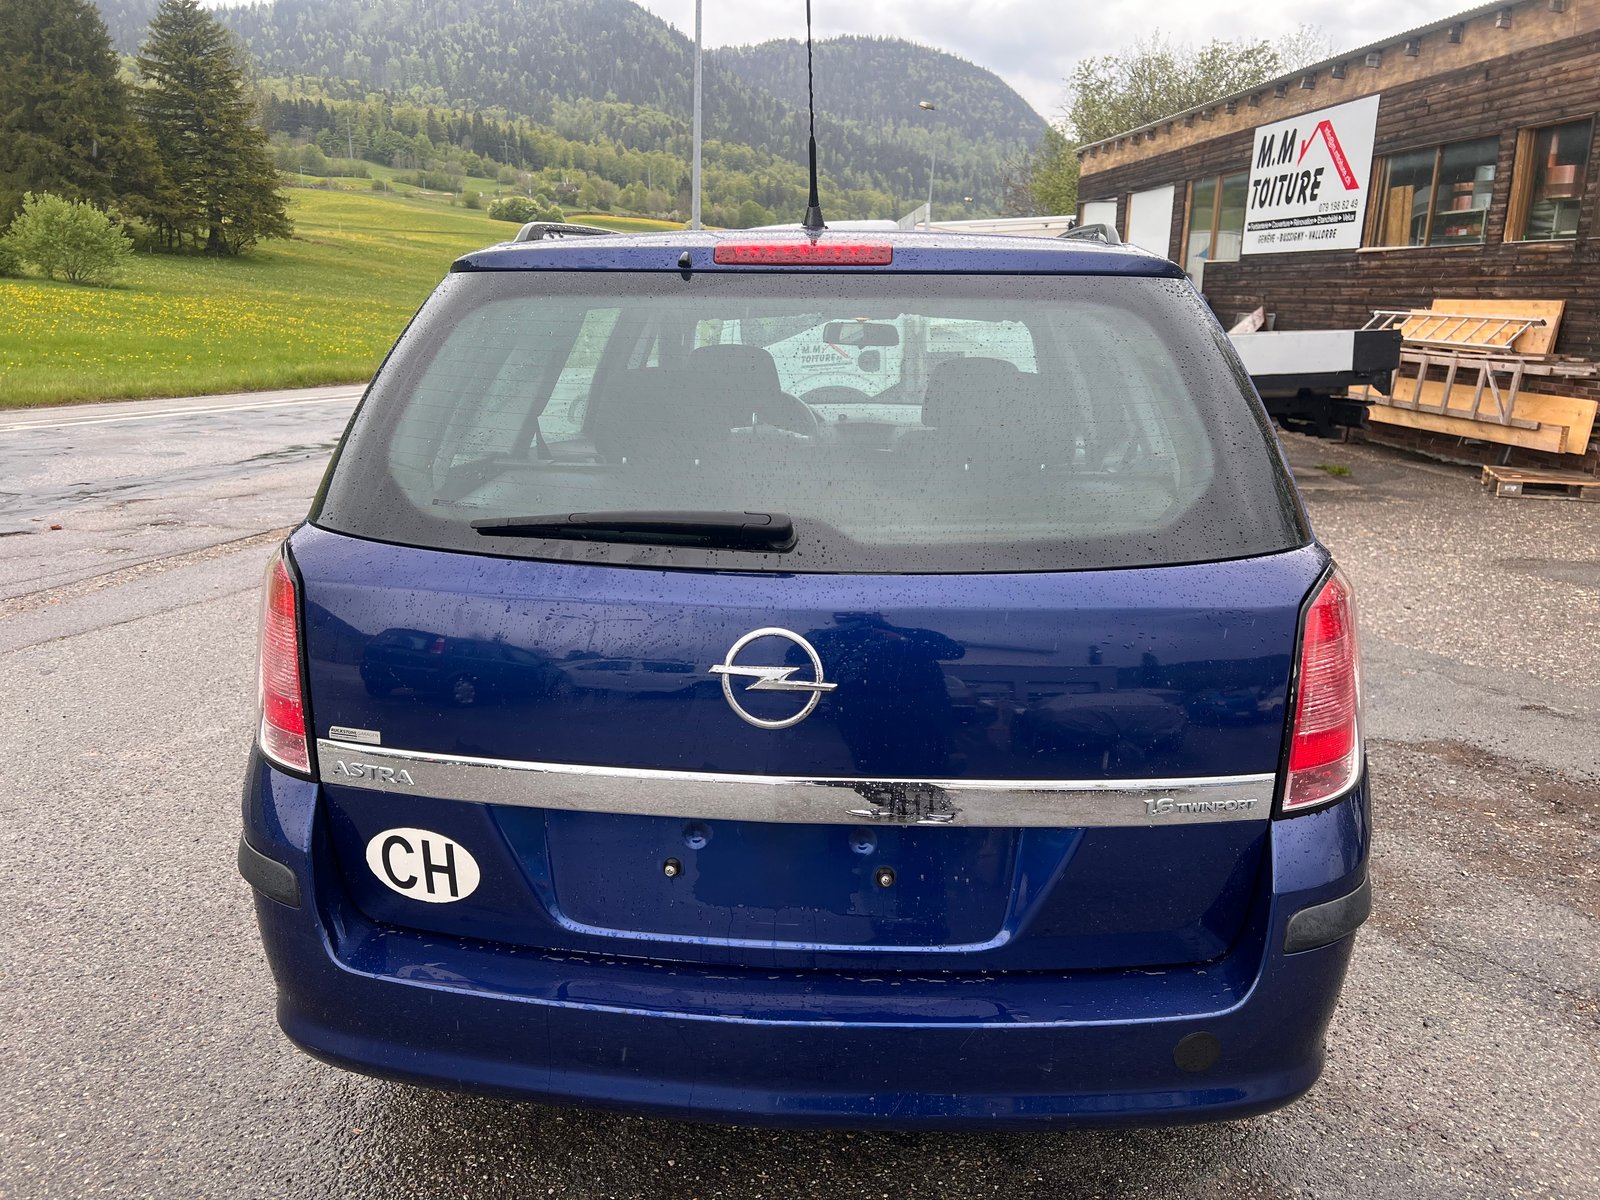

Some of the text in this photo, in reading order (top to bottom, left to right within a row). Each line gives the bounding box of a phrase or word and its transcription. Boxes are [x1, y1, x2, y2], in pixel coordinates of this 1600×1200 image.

[1256, 128, 1297, 169] M.M
[1251, 167, 1324, 210] TOITURE
[1319, 202, 1329, 213] 079
[1350, 198, 1359, 209] 49
[1342, 212, 1355, 222] Velux
[1280, 231, 1304, 242] BUSSIGNY
[1308, 228, 1337, 240] VALLORBE
[801, 353, 838, 363] TOITURE
[333, 760, 415, 786] ASTRA
[1144, 798, 1258, 815] 1.6 TWINPORT
[382, 835, 459, 898] CH
